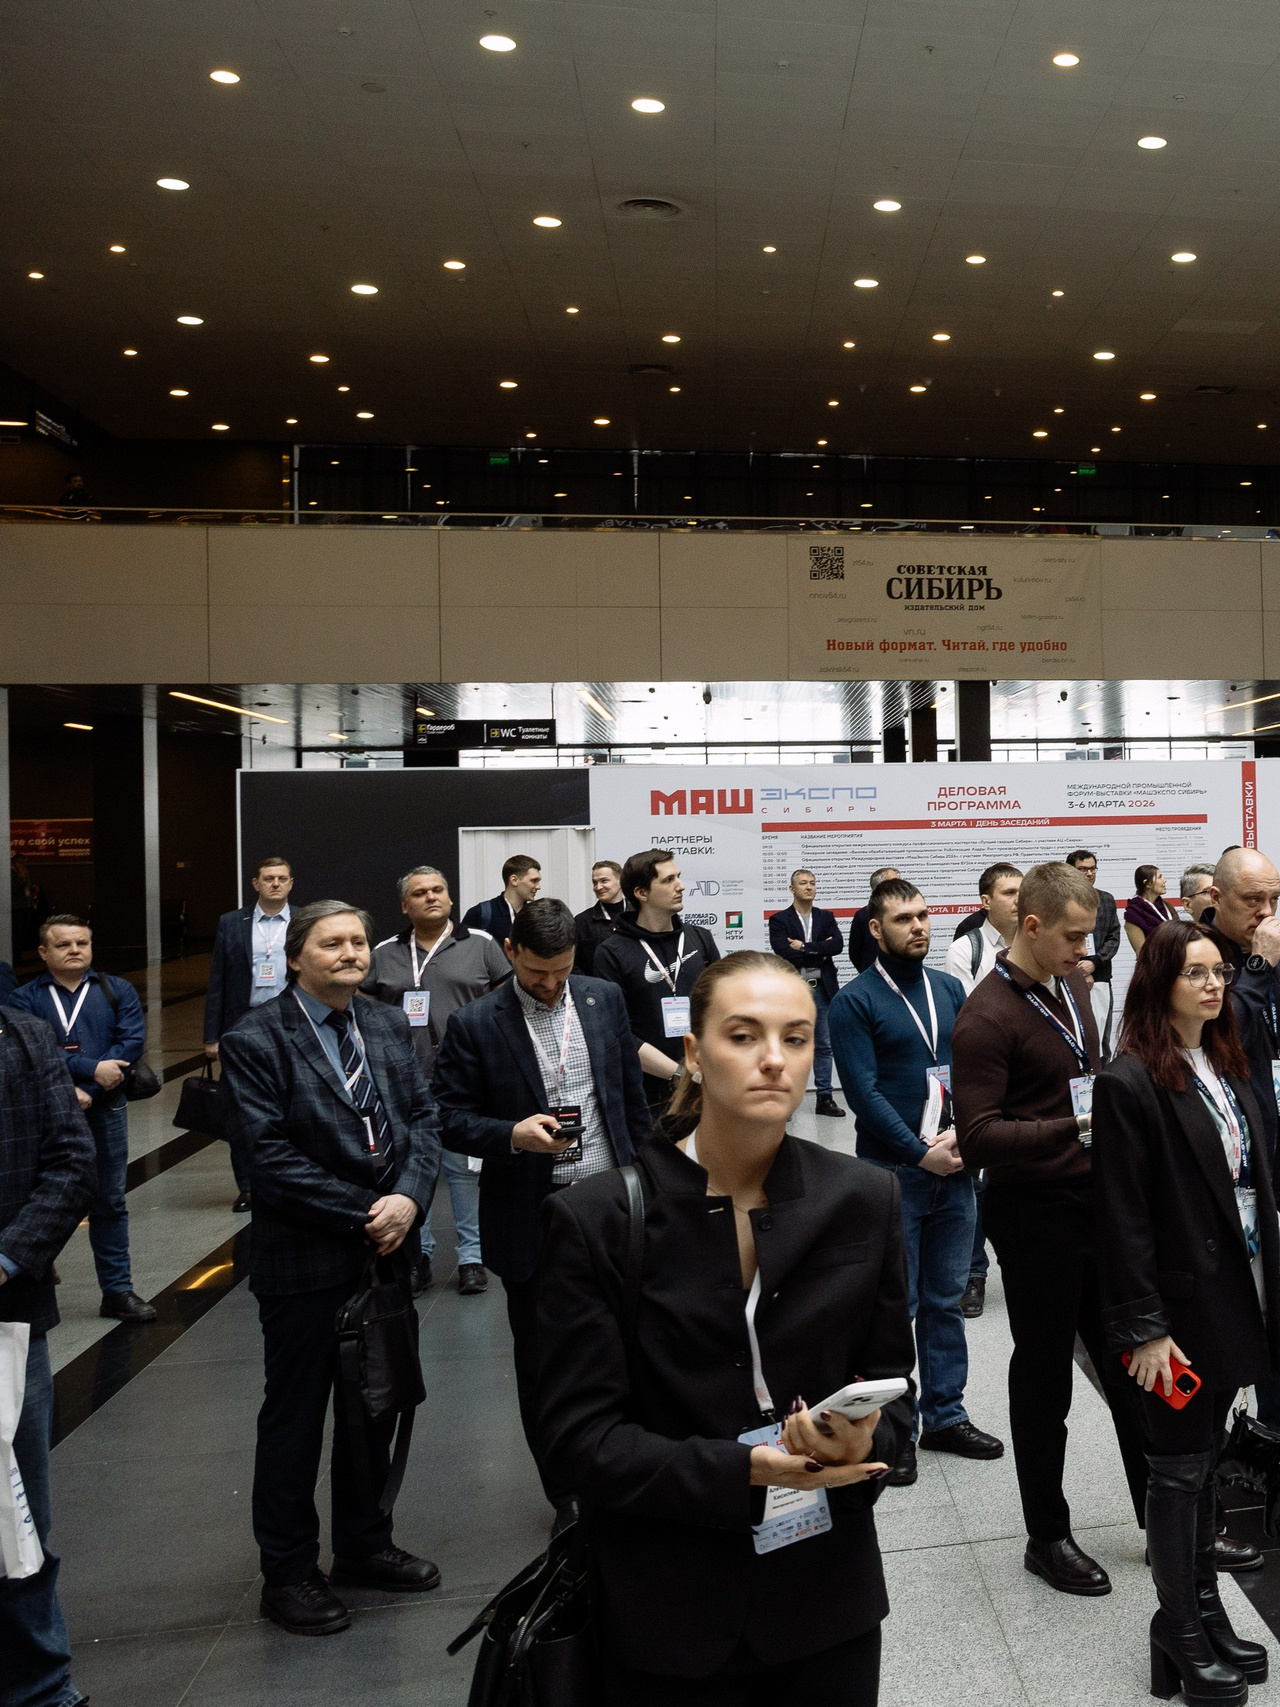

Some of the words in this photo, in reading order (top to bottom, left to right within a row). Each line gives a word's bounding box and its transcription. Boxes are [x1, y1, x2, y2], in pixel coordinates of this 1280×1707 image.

[896, 565, 988, 576] СОВЕТСКАЯ
[886, 577, 1002, 600] СИБИРЬ
[904, 603, 965, 612] издательский
[826, 639, 874, 651] Новый
[879, 639, 937, 654] формат.
[942, 639, 989, 653] Читай,
[992, 641, 1015, 653] где
[1019, 639, 1068, 653] удобно
[500, 728, 517, 738] WC
[1132, 781, 1192, 789] ПРОМЫШЛЕННОЙ
[938, 786, 1007, 799] ДЕЛОВАЯ
[650, 788, 753, 816] МАШ
[760, 787, 877, 800] ЭКСПО
[928, 800, 1022, 811] ПРОГРАММА
[1068, 801, 1086, 809] 3-6
[1088, 800, 1126, 809] МАРТА
[1128, 799, 1156, 808] 2026
[1244, 781, 1255, 849] ВЫСТАВКИ
[937, 820, 967, 828] МАРТА
[976, 820, 999, 828] ДЕНЬ
[1000, 817, 1050, 827] ЗАСЕДАНИЙ
[28, 836, 55, 846] свой
[58, 837, 91, 847] успех
[651, 835, 713, 845] ПАРТНЕРЫ
[657, 846, 715, 855] СТАВКИ:
[957, 906, 980, 914] ДЕНЬ
[684, 918, 709, 926] РОССИЯ
